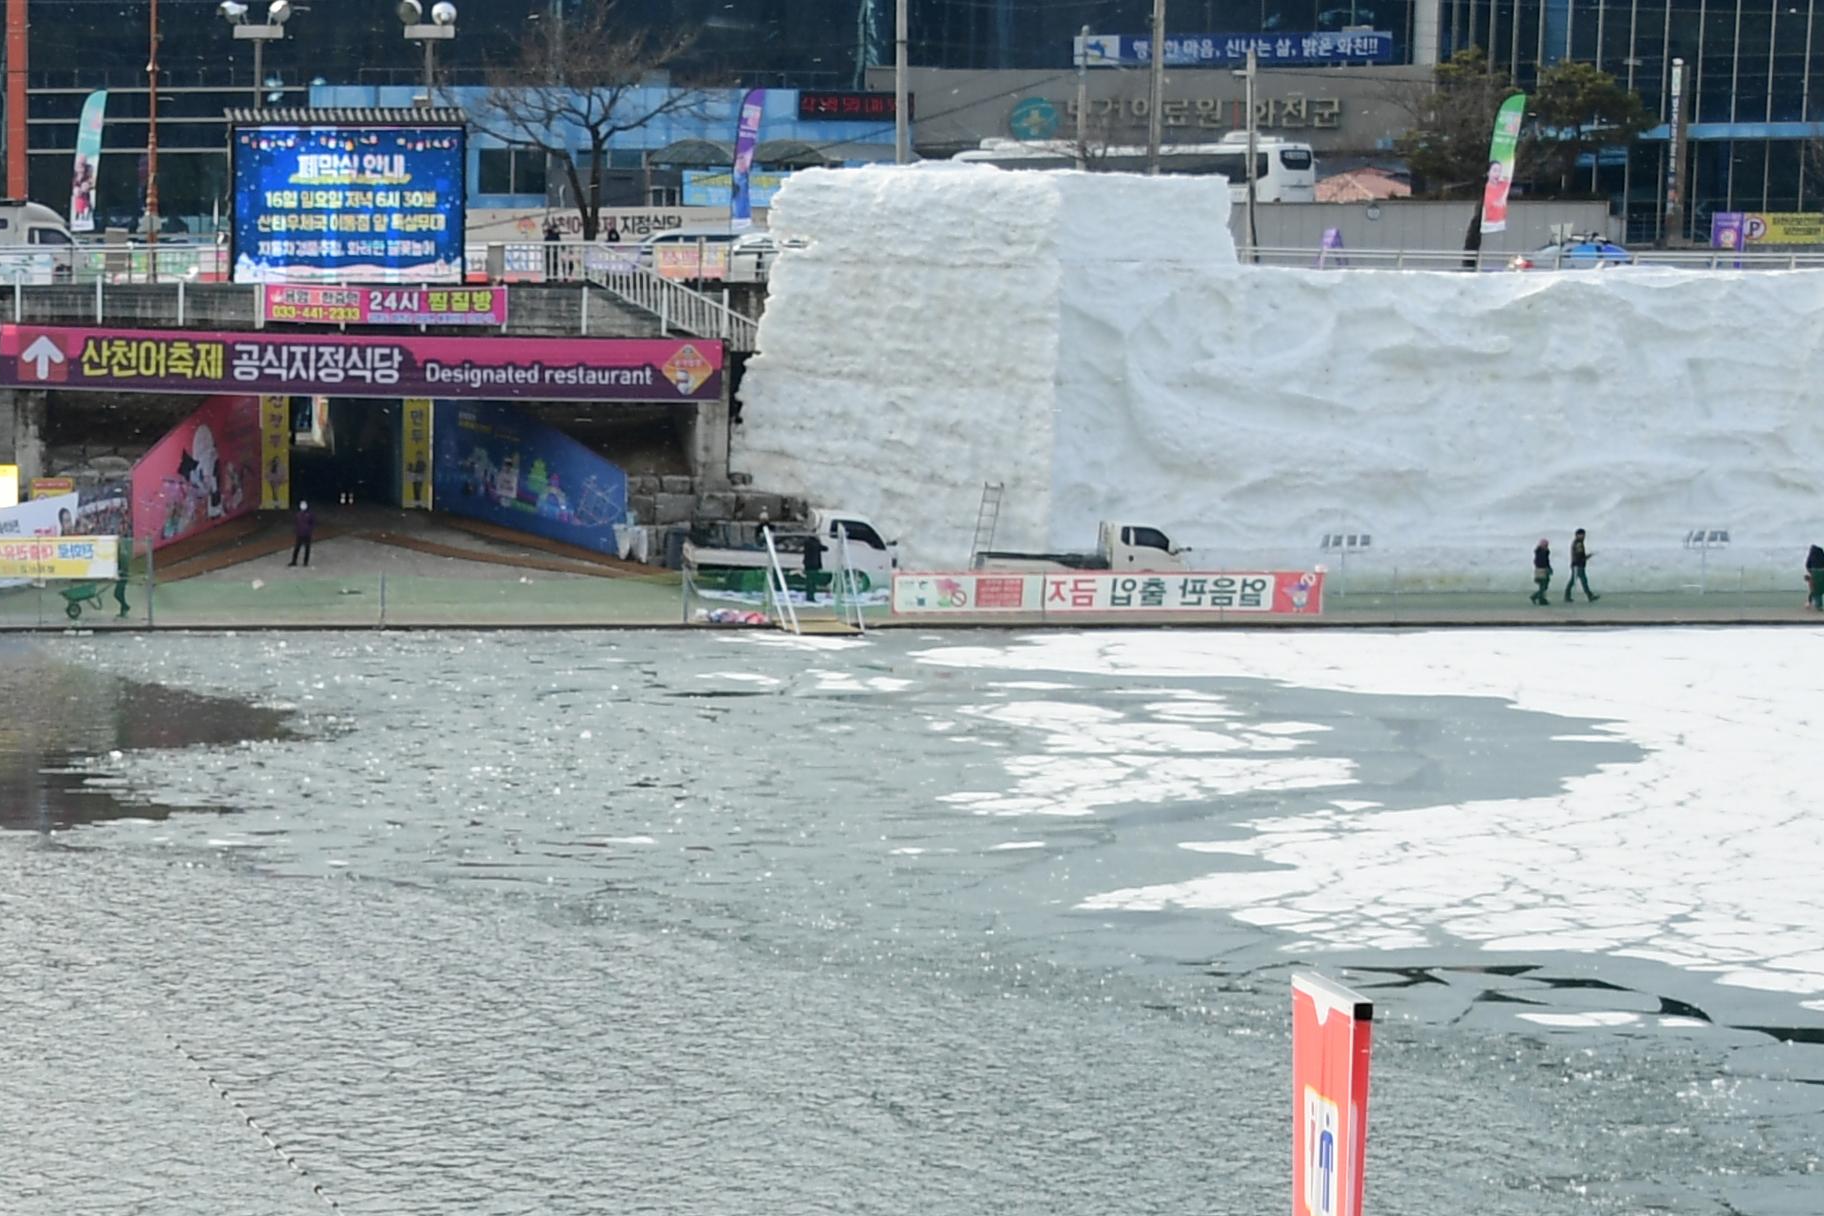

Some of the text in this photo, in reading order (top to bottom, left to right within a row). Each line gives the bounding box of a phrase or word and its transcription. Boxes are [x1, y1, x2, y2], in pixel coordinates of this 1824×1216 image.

[1133, 39, 1182, 59] 행한
[1227, 37, 1271, 57] 신나는
[1254, 98, 1341, 128] 화천군
[297, 154, 405, 178] 폐막식 안내
[301, 191, 342, 208] 일요일
[376, 191, 400, 208] 6시
[403, 191, 437, 208] 30분
[621, 215, 682, 235] 지정식당
[370, 291, 419, 312] 24시
[428, 291, 493, 312] 찜질방
[80, 339, 404, 384] 산천어축제 공식지정식당
[425, 362, 653, 388] Designated restaurant
